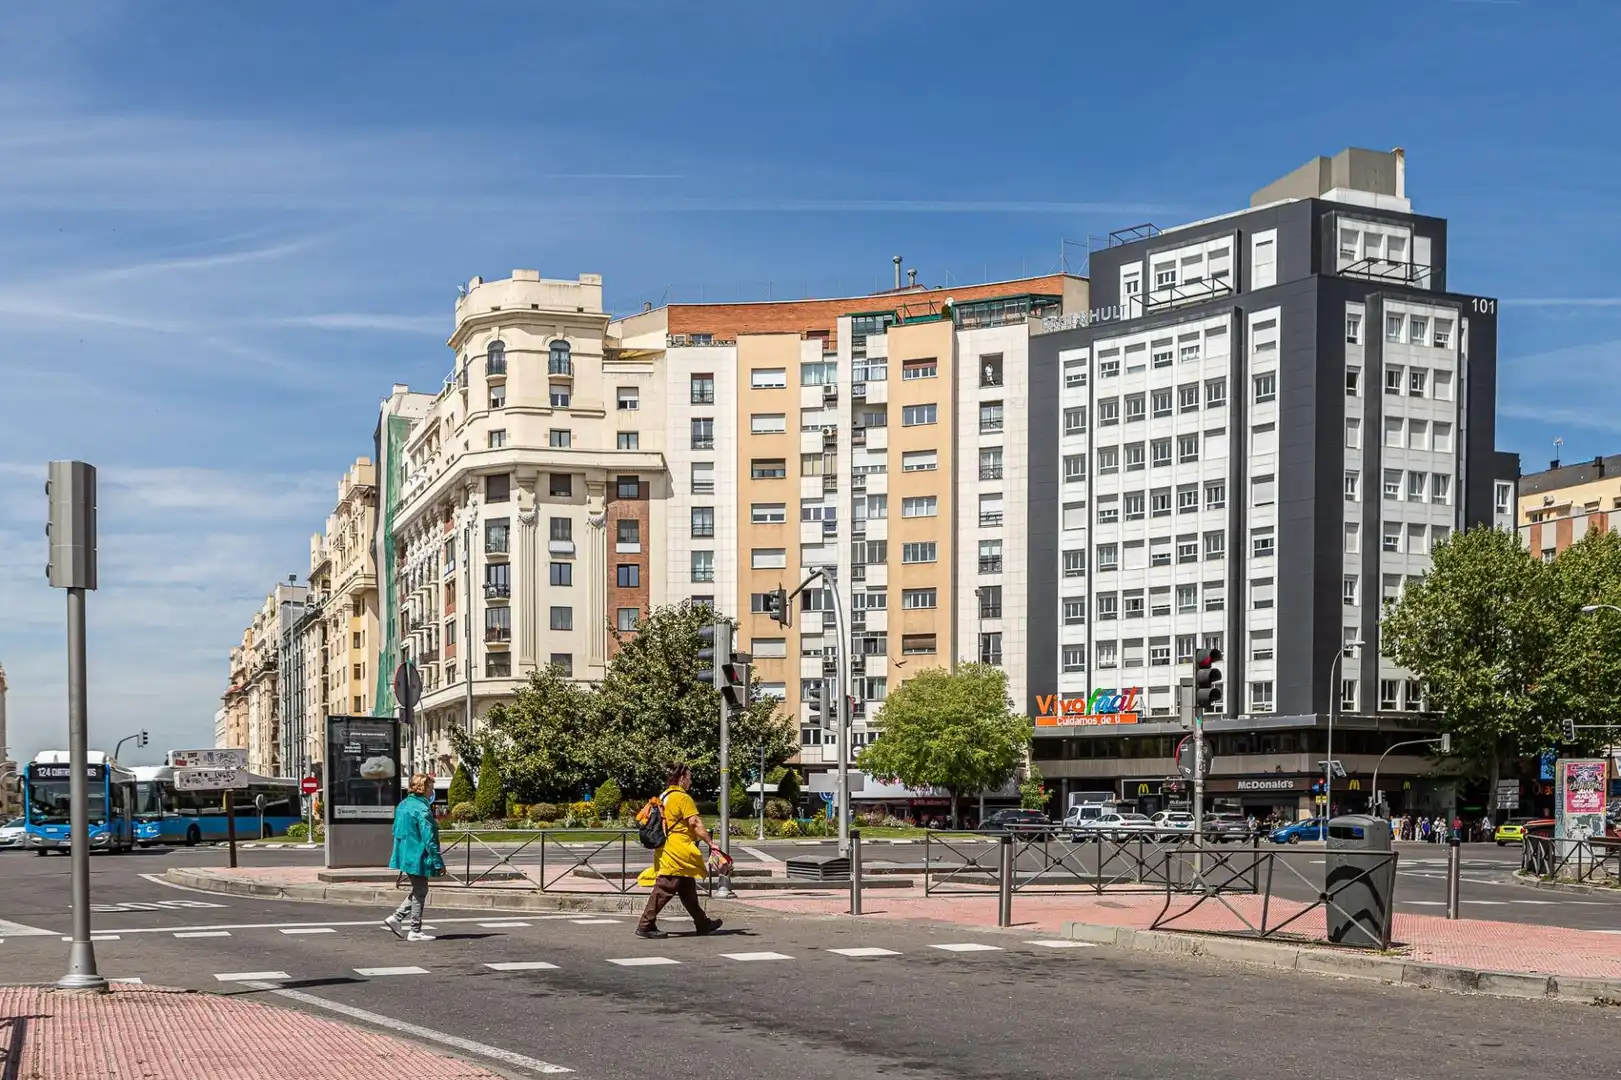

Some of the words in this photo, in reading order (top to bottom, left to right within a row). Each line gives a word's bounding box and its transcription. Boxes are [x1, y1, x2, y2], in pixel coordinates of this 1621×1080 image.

[1472, 298, 1494, 314] 101
[1057, 715, 1097, 727] Cuidamos
[1101, 714, 1112, 724] de
[37, 767, 51, 777] 124
[1237, 780, 1294, 790] McDonald's
